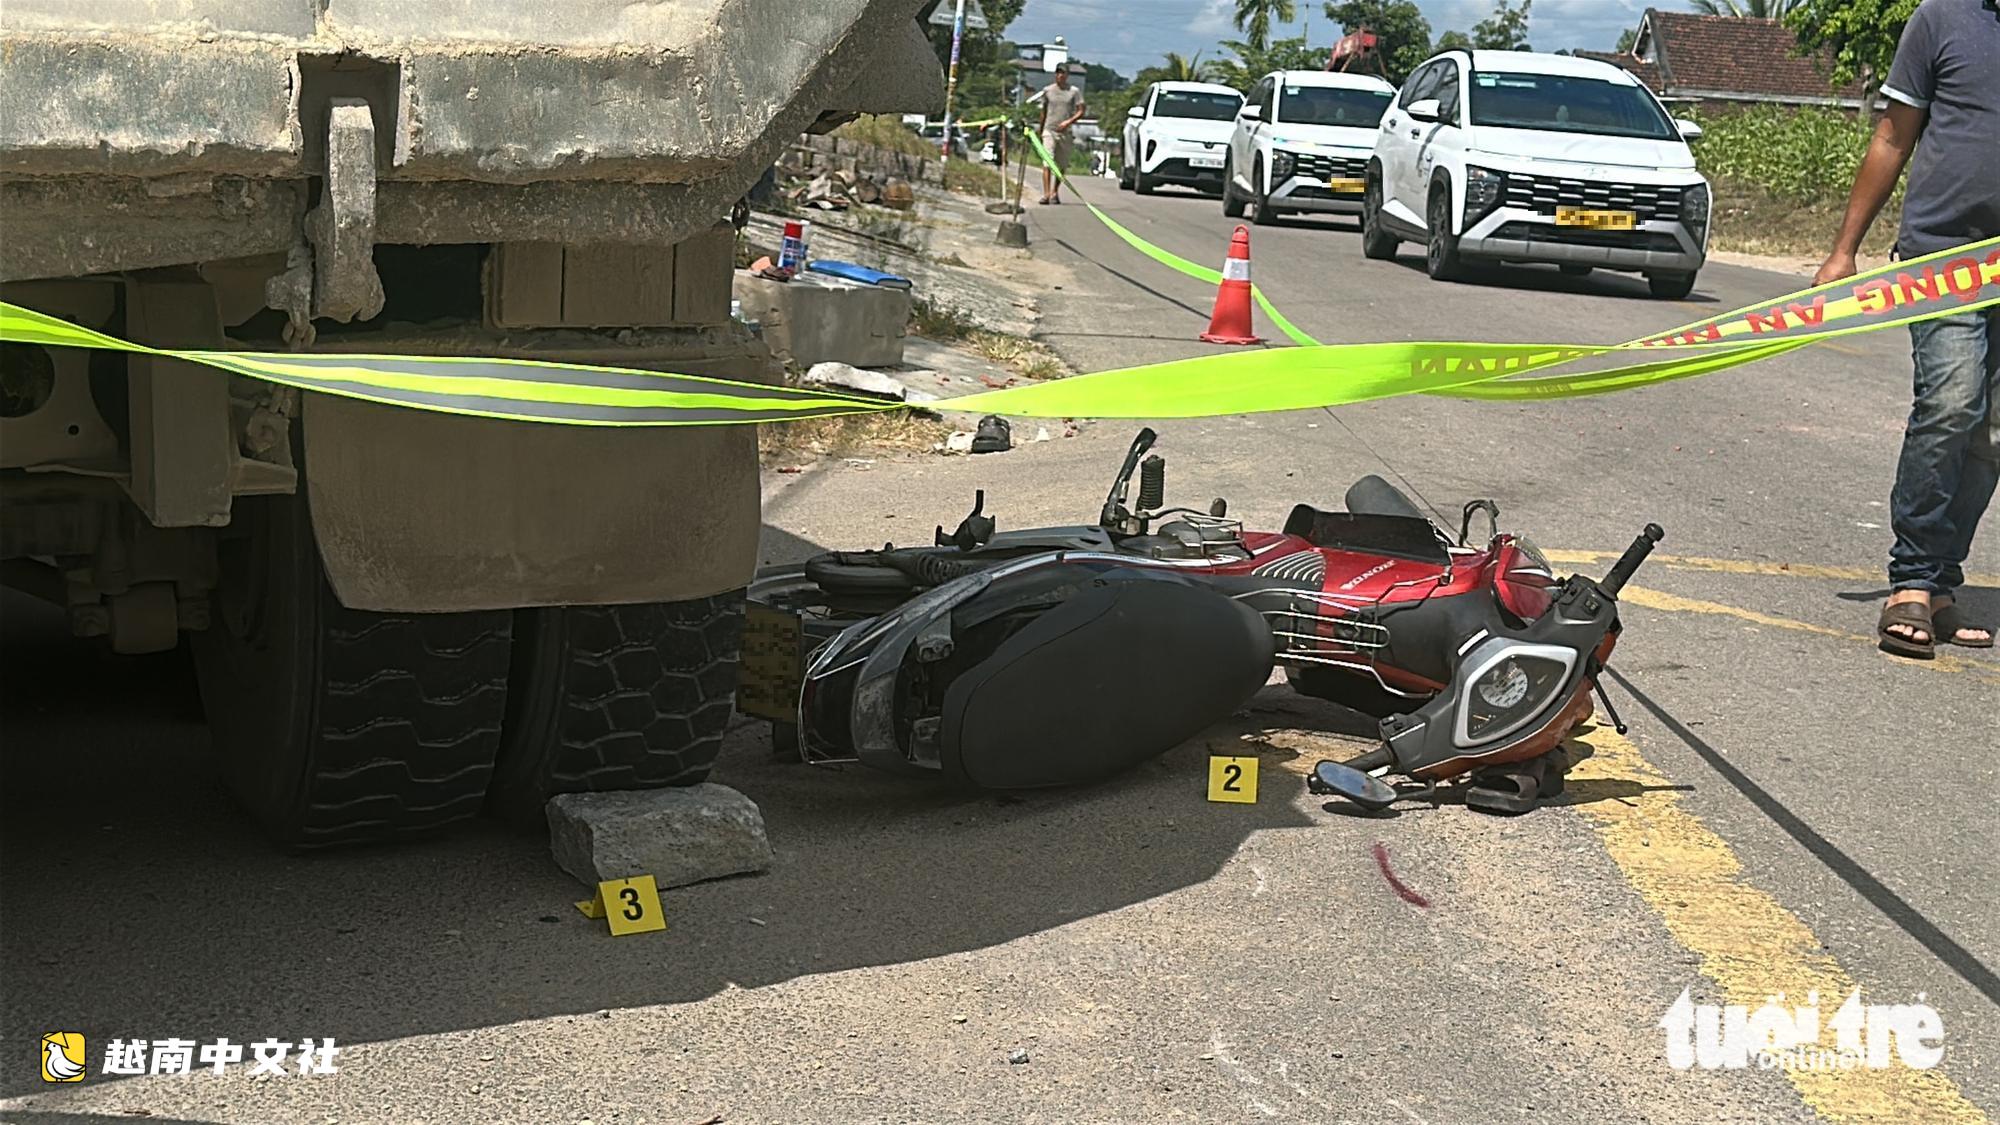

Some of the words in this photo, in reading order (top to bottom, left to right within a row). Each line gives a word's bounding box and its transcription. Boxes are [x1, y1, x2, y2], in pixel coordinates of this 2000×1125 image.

[1744, 294, 1827, 335] AN
[1340, 559, 1396, 590] HONDA
[1223, 764, 1242, 792] 2
[619, 887, 644, 921] 3
